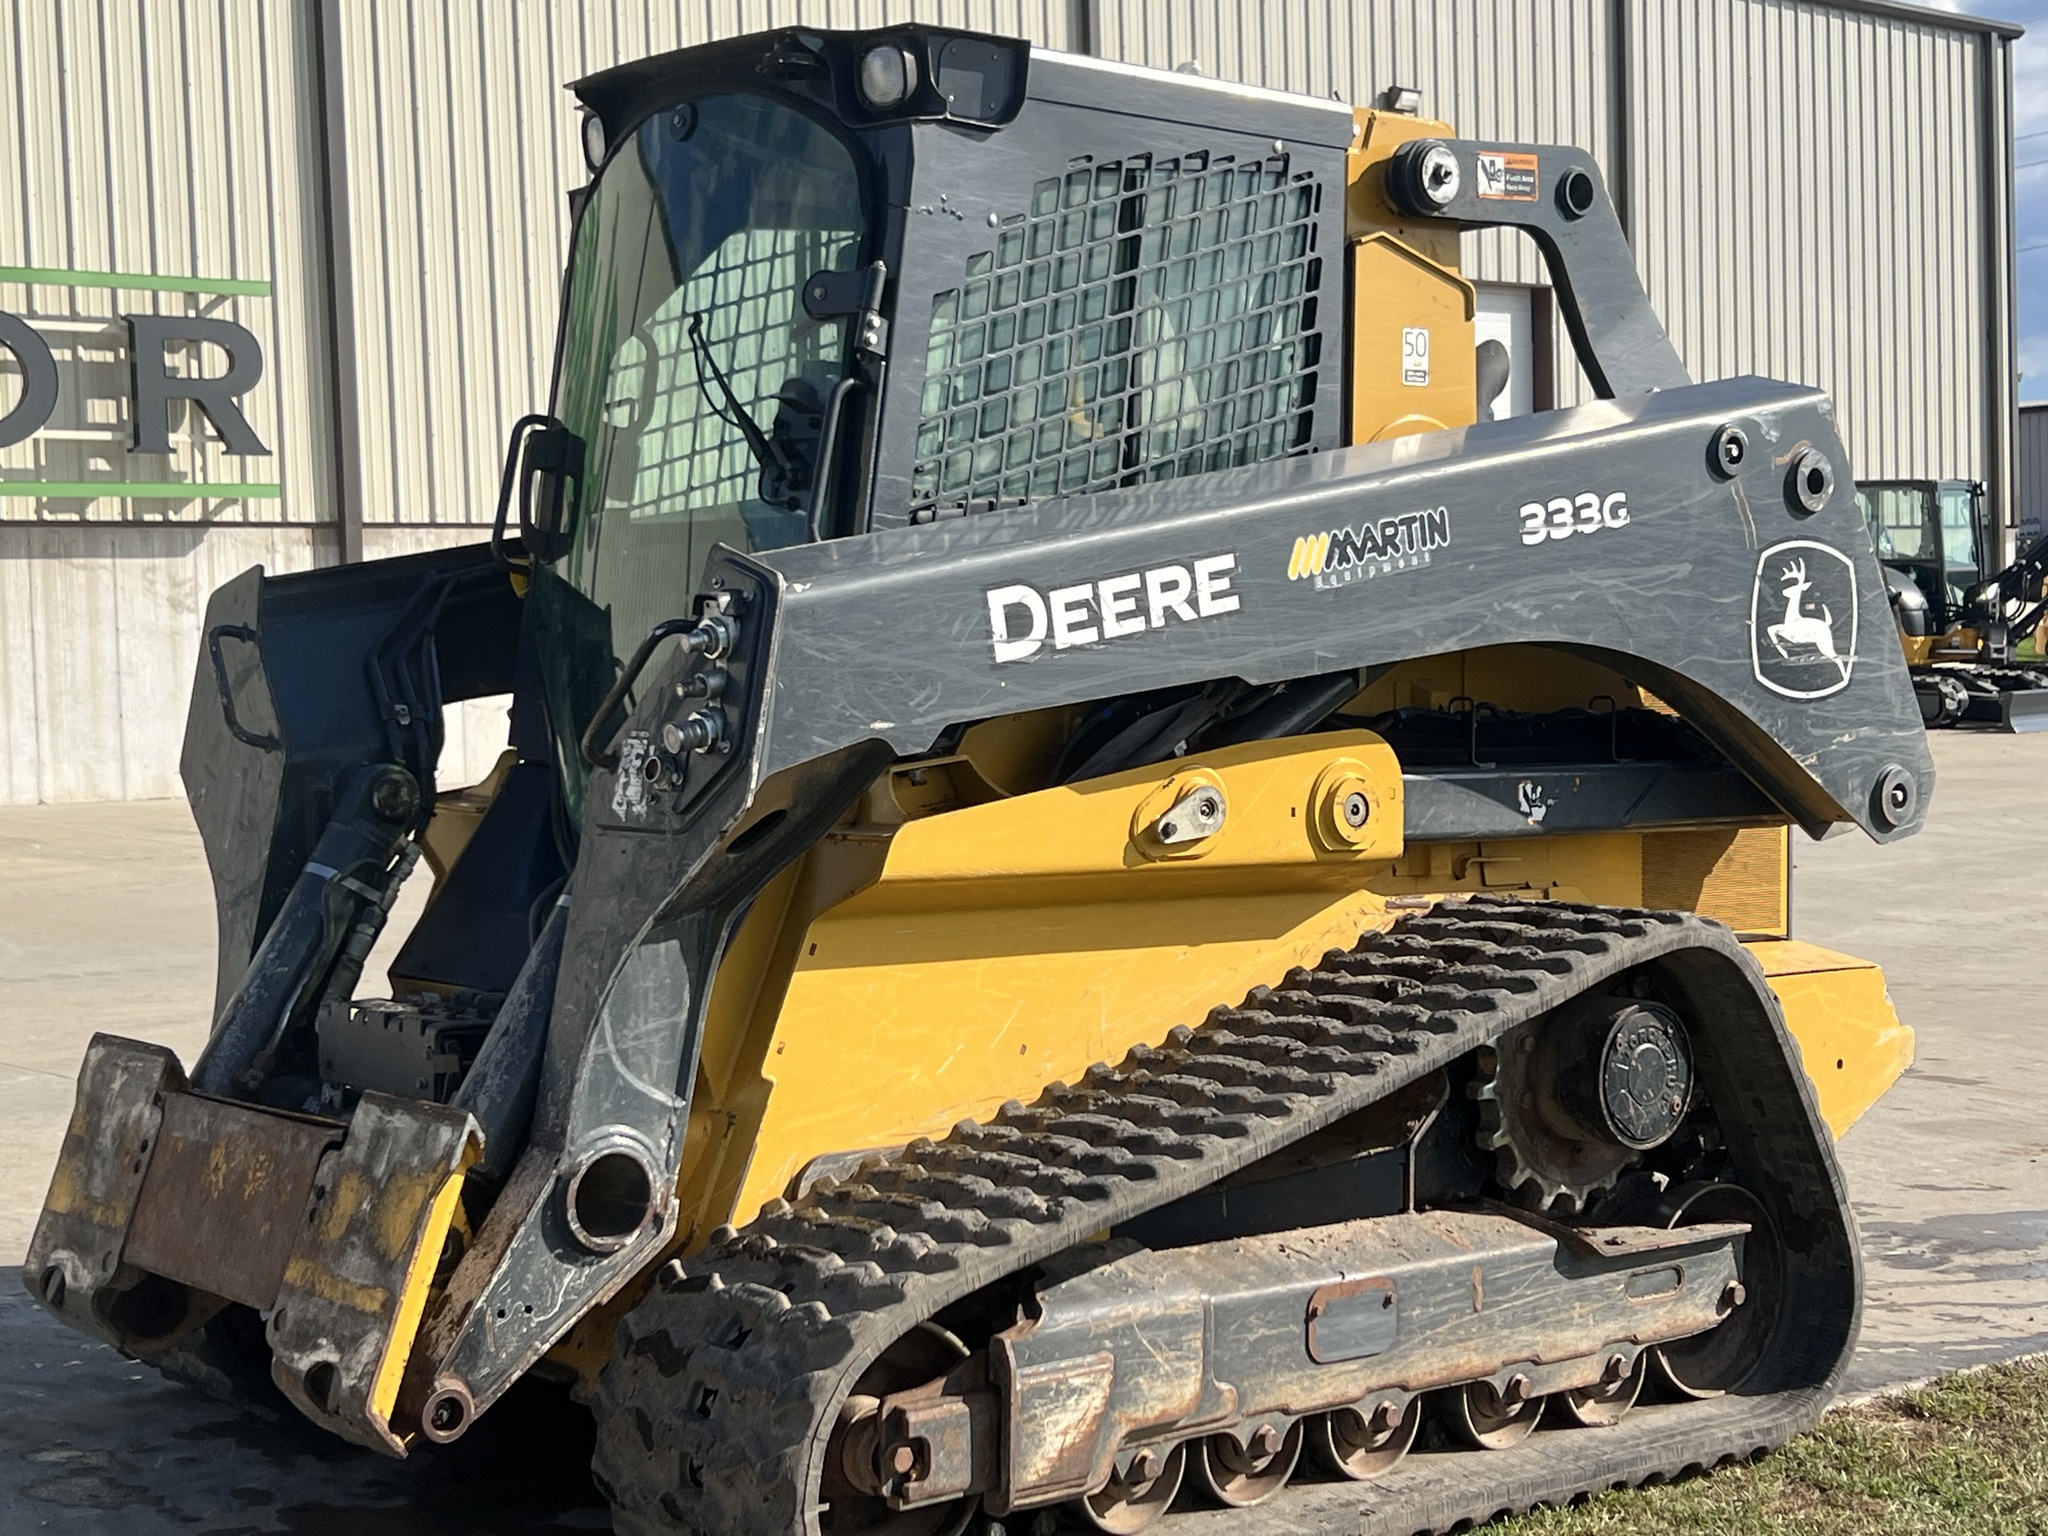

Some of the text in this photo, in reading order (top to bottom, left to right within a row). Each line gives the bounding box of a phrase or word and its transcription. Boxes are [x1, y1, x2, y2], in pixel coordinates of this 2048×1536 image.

[1404, 331, 1427, 358] 50
[1322, 505, 1451, 572] MARTIN
[1519, 491, 1631, 546] 333G
[986, 552, 1241, 664] DEERE
